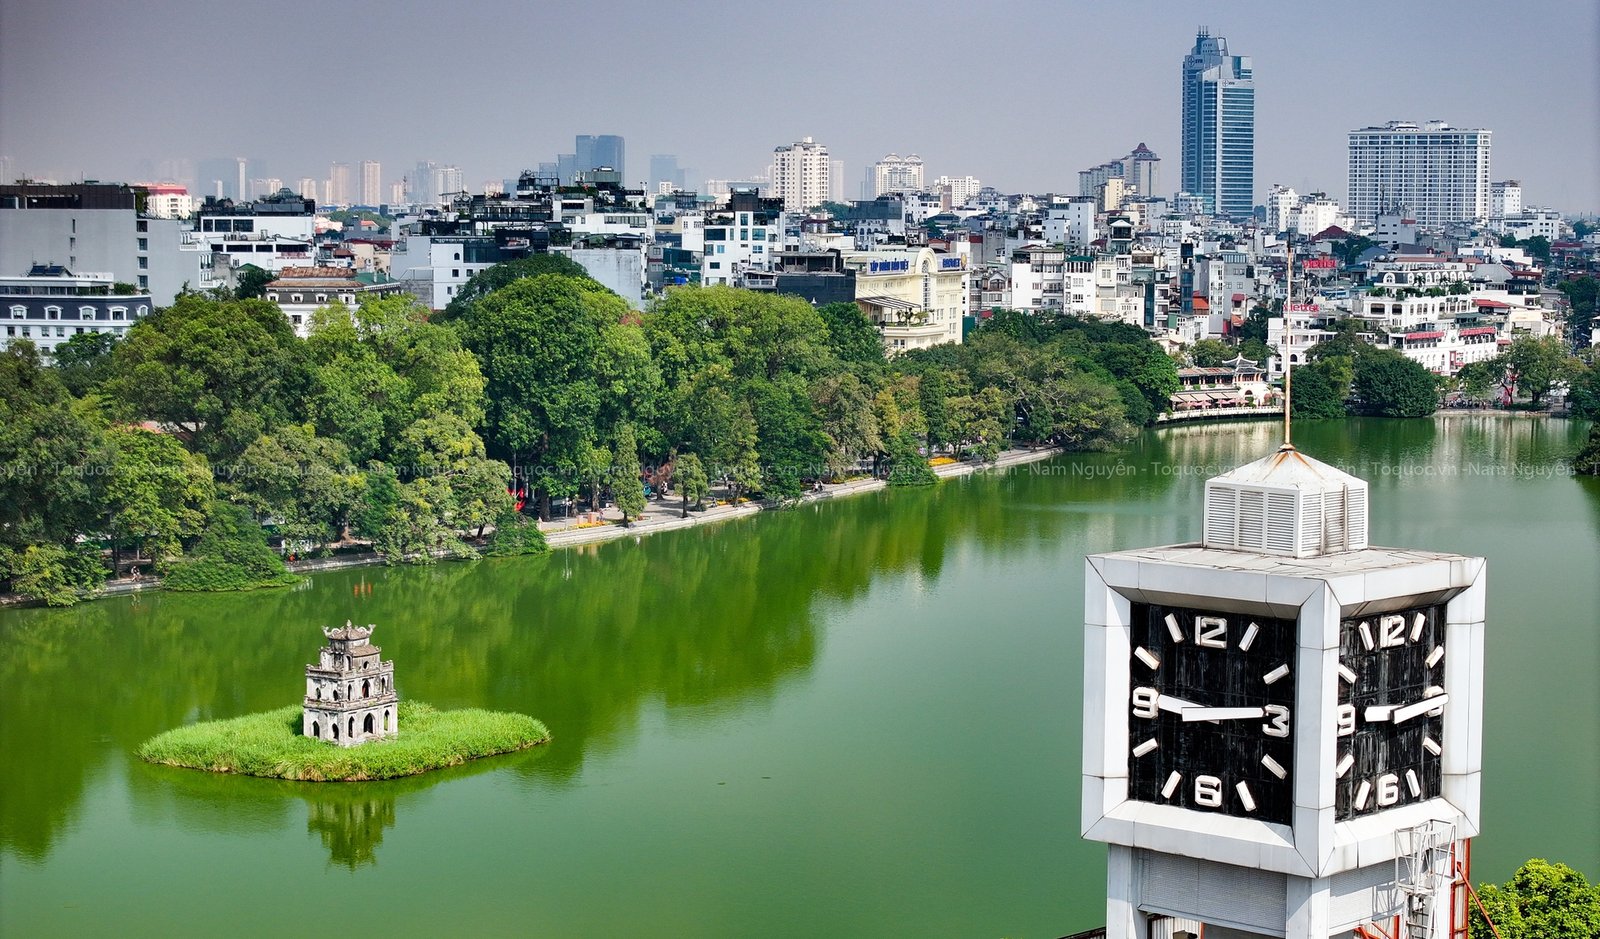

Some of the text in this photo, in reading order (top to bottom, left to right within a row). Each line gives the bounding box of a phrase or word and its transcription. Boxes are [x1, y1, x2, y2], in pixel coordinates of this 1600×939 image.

[1194, 615, 1227, 649] 12
[1380, 614, 1405, 648] 12
[1133, 687, 1159, 719] 9
[1337, 703, 1355, 737] 9
[1262, 704, 1290, 738] 3
[1194, 775, 1222, 807] 6
[1378, 773, 1399, 807] 6
